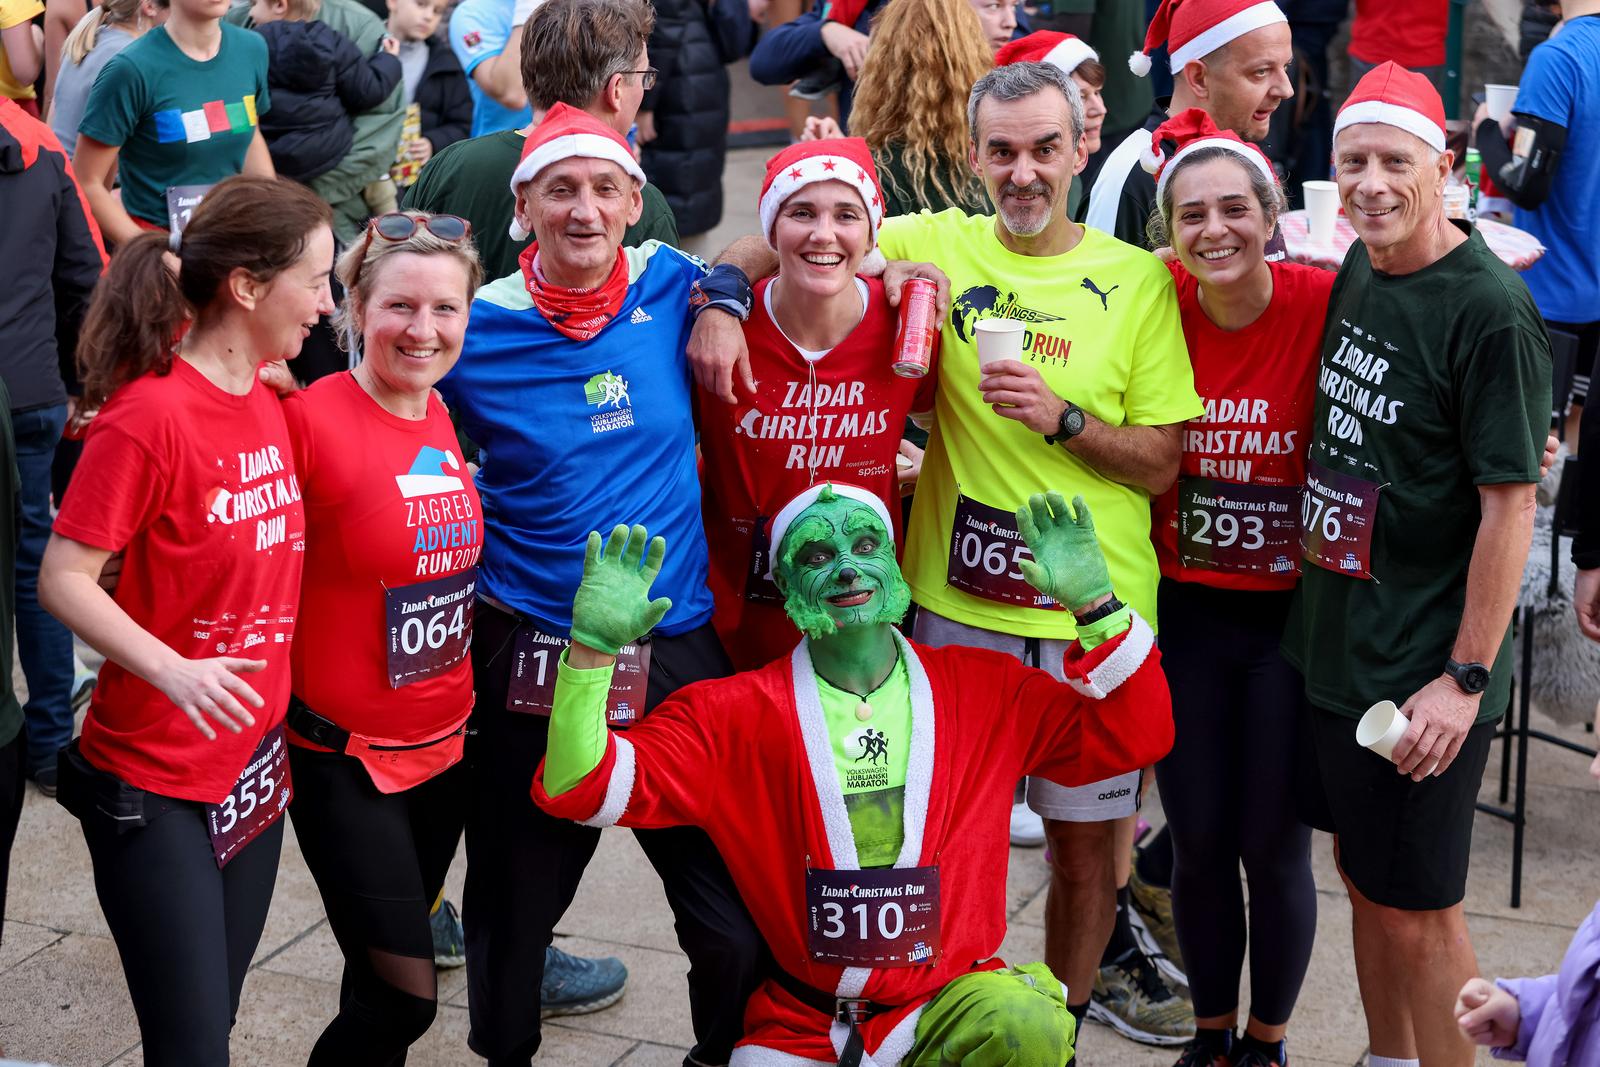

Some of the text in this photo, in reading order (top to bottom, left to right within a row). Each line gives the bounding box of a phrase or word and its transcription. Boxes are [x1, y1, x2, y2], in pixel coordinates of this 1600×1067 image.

[631, 314, 653, 324] adidas
[995, 302, 1037, 320] WINGS
[1033, 332, 1072, 360] RUN
[1030, 353, 1067, 368] 2017
[1331, 335, 1390, 385] ZADAR
[781, 381, 865, 408] ZADAR
[590, 407, 632, 421] VOLKSWAGEN
[591, 414, 633, 427] LJUBLJANSKI
[593, 419, 634, 433] MARATON
[741, 408, 890, 439] CHRISTMAS
[1327, 404, 1363, 446] RUN
[238, 445, 284, 483] ZADAR
[785, 444, 845, 469] RUN
[1200, 458, 1252, 482] RUN
[404, 493, 473, 528] ZAGREB
[1192, 492, 1288, 513] ZADAR CHRISTMAS RUN
[1345, 492, 1364, 508] RUN
[966, 514, 1024, 541] ZADAR CHRIST
[1191, 509, 1265, 550] 293
[1302, 490, 1341, 542] 076
[255, 514, 286, 551] RUN
[413, 519, 478, 554] ADVENT
[415, 550, 453, 577] RUN
[961, 532, 1035, 580] 065
[401, 600, 428, 615] ZADAR
[428, 587, 467, 608] CHRISTMAS
[401, 603, 465, 655] 064
[532, 631, 561, 646] ZADAR
[240, 750, 273, 780] CHRISTMAS
[846, 766, 888, 776] VOLKSWAGEN
[846, 773, 888, 781] LJUBLJANSKI
[846, 779, 889, 789] MARATON
[1098, 787, 1131, 801] adidas
[219, 763, 276, 834] 355
[821, 883, 925, 898] ZADAR CHRISTMAS RUN
[822, 902, 904, 940] 310
